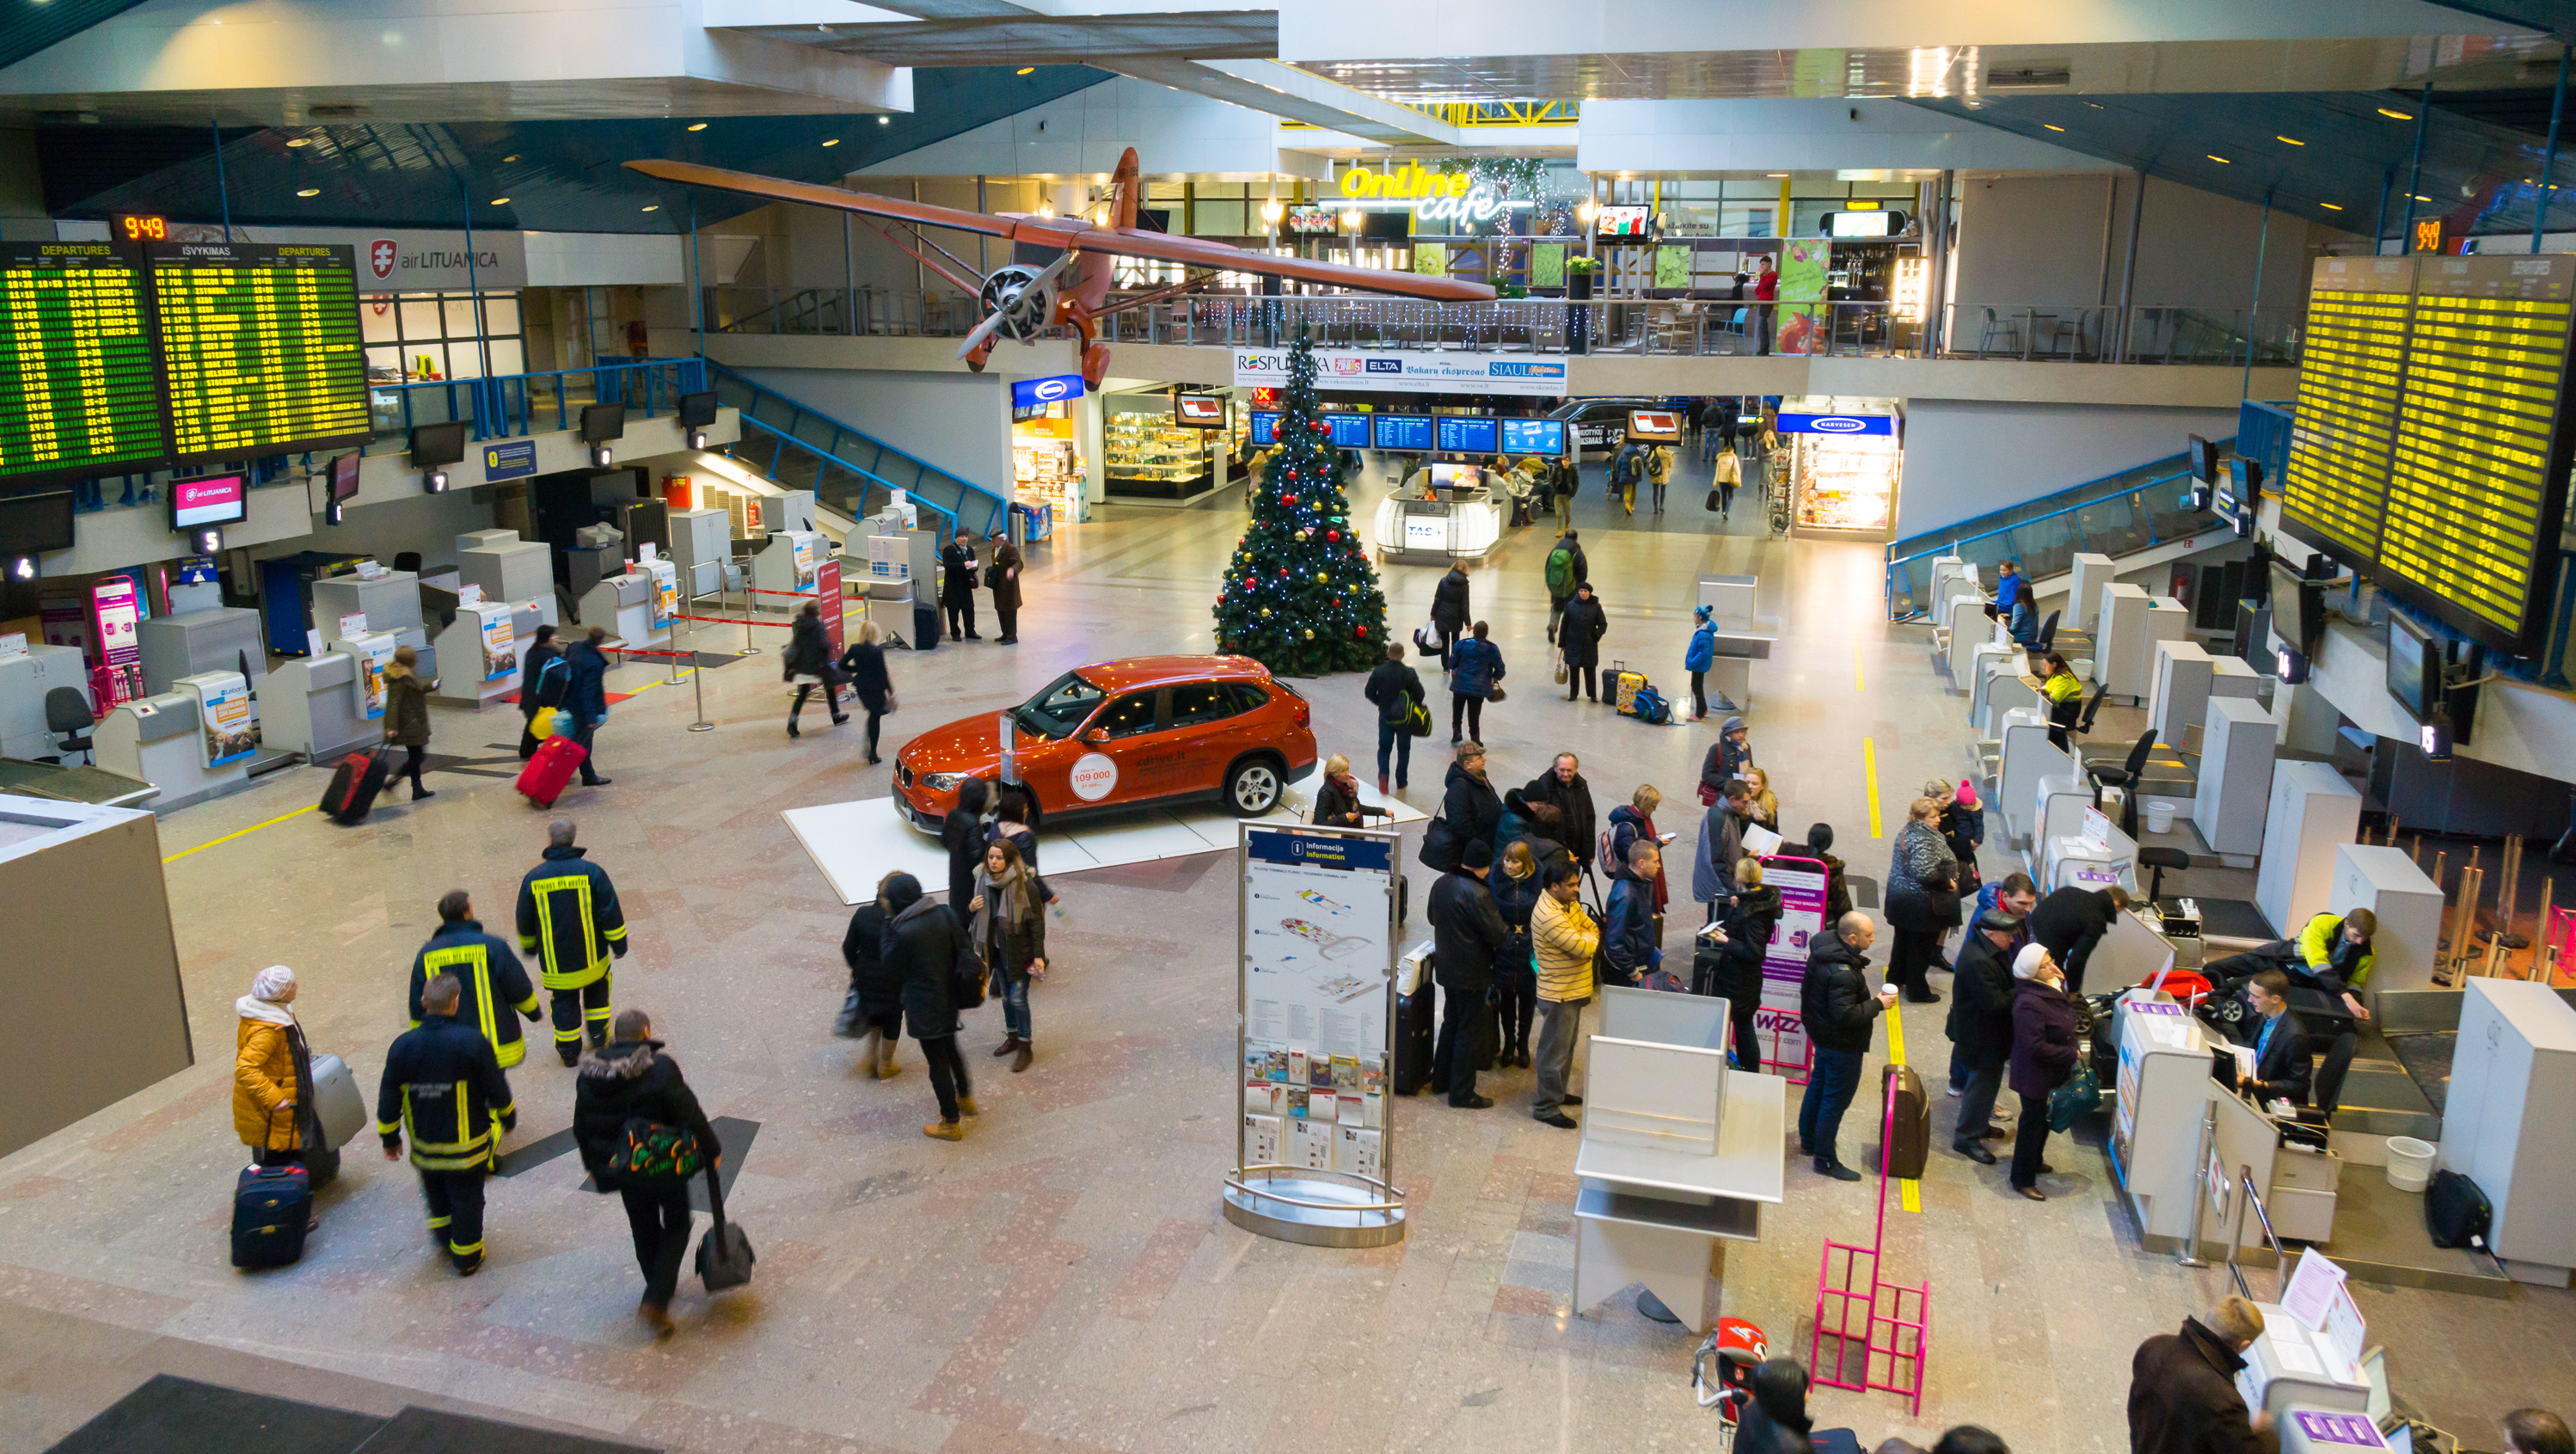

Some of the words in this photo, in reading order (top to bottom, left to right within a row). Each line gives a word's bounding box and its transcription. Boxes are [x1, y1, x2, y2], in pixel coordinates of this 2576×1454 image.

[1341, 167, 1471, 198] OnLine
[1417, 186, 1500, 226] cafe
[41, 246, 111, 255] DEPARTURES
[182, 245, 230, 256] IŠVYKIMAS
[279, 247, 331, 256] DEPARTURES
[402, 253, 419, 268] air
[1369, 361, 1399, 371] ELTA
[1406, 365, 1438, 377] Vakarų
[1442, 366, 1486, 377] ekspresas
[696, 433, 705, 450] 9
[436, 475, 445, 491] 7
[203, 487, 232, 497] LITUANICA
[1408, 526, 1432, 536] TAS
[205, 531, 218, 550] 5
[17, 559, 33, 578] 4
[2279, 651, 2290, 678] 14
[225, 686, 246, 695] Lebara
[2421, 726, 2434, 754] 15
[1136, 751, 1186, 767] xdrive.lt
[1074, 773, 1091, 782] 109
[1093, 770, 1111, 780] 000
[1306, 842, 1344, 852] Informacija
[1306, 851, 1346, 861] Information
